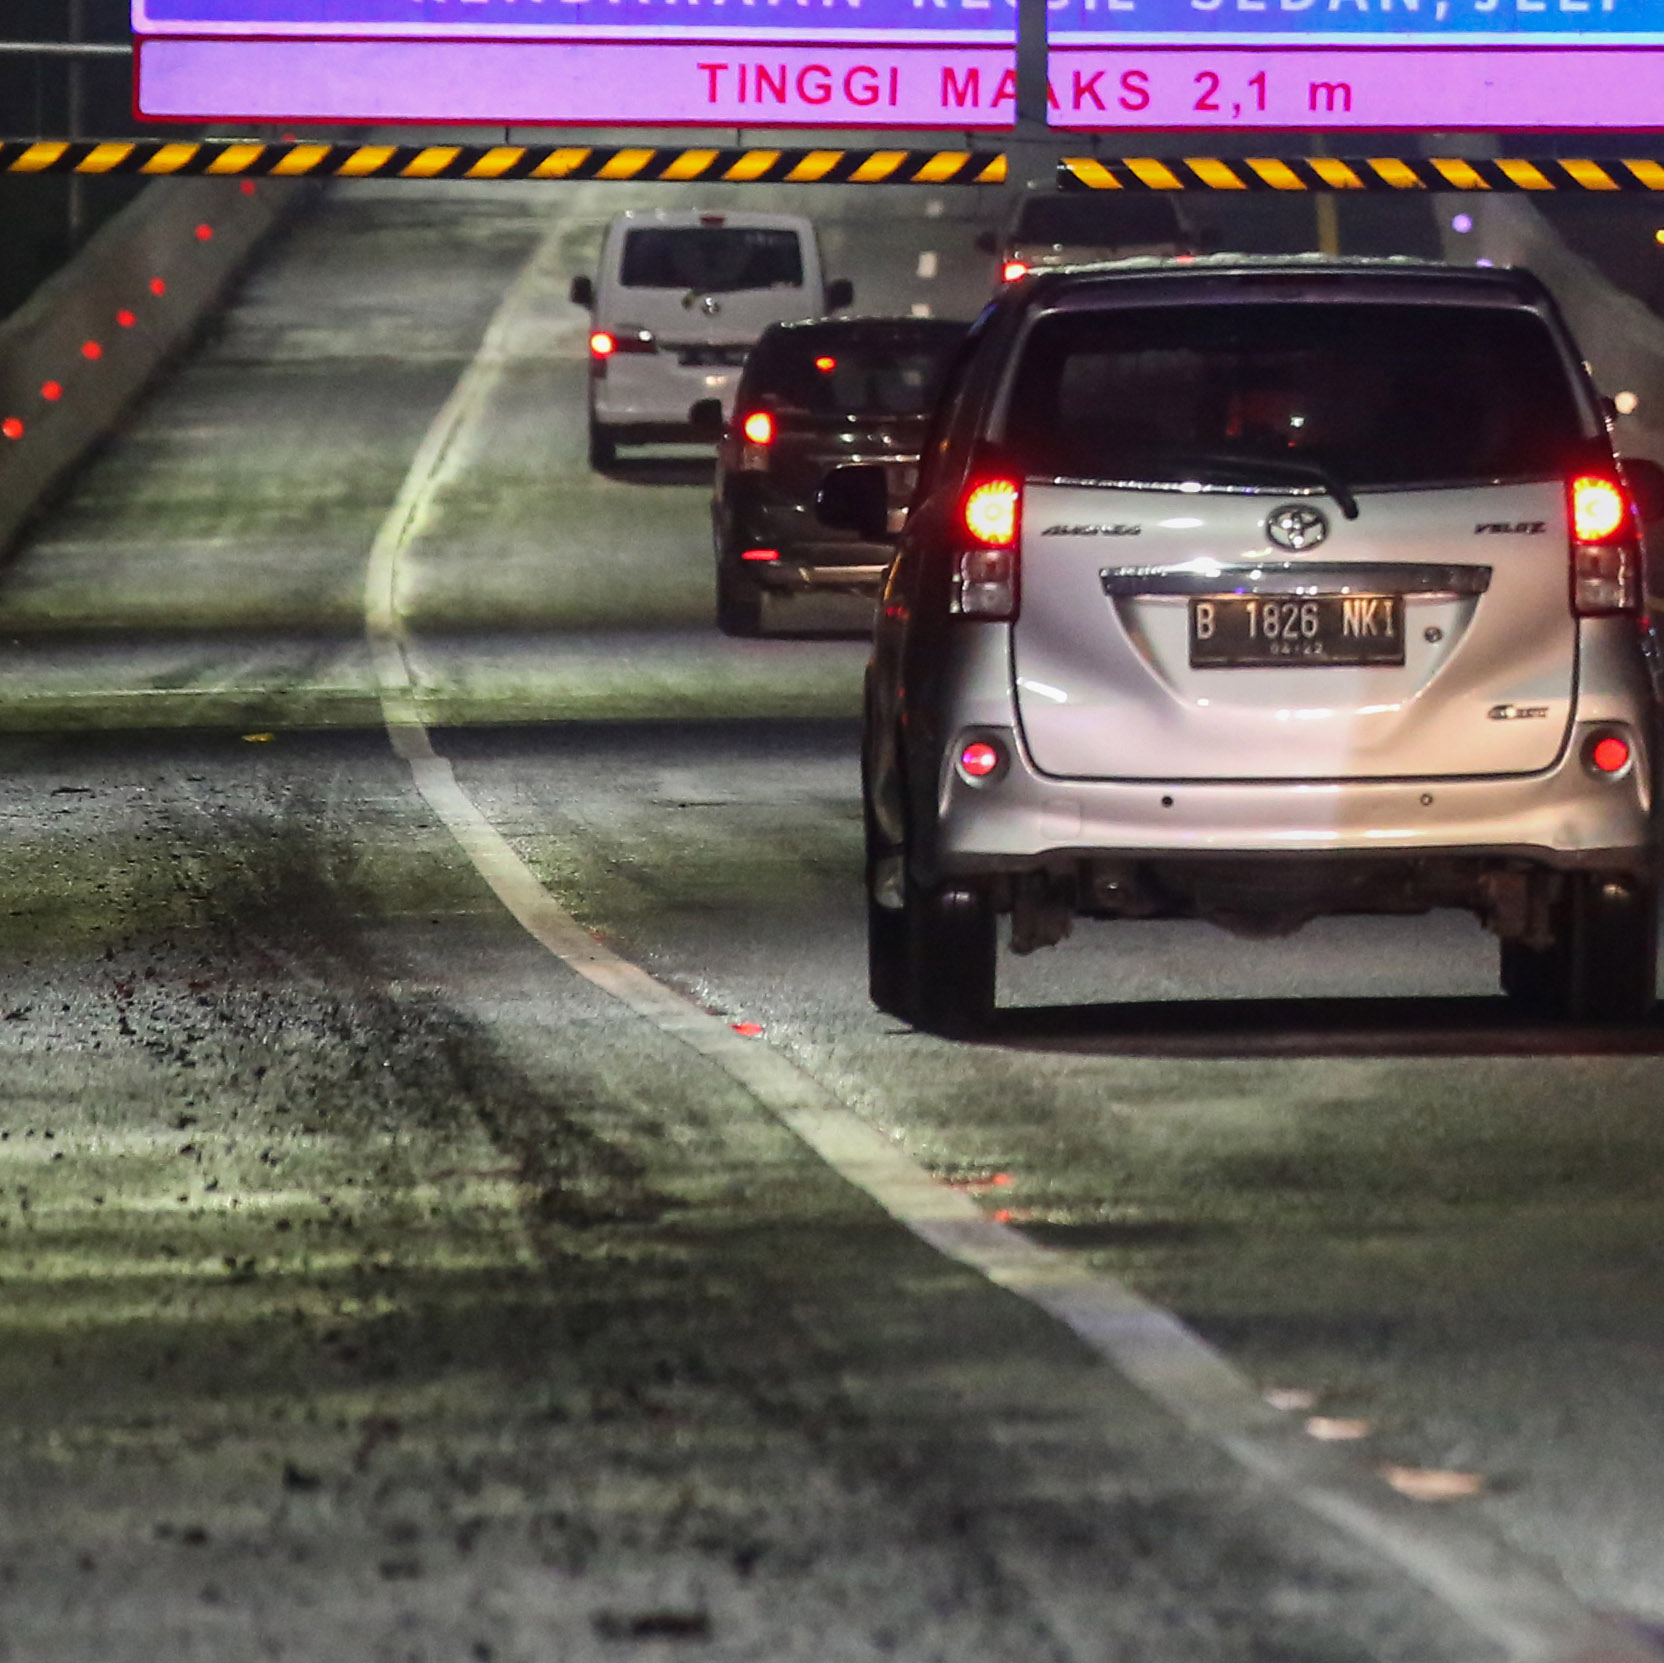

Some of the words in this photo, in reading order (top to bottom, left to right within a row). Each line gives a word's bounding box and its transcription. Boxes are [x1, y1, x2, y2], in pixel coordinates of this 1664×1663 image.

[696, 61, 899, 108] TINGGI
[941, 65, 1151, 112] MAKS
[1191, 68, 1270, 118] 2,1
[1308, 79, 1354, 112] m
[1196, 600, 1217, 640] B
[1246, 600, 1320, 639] 1826
[1341, 598, 1395, 638] NKI
